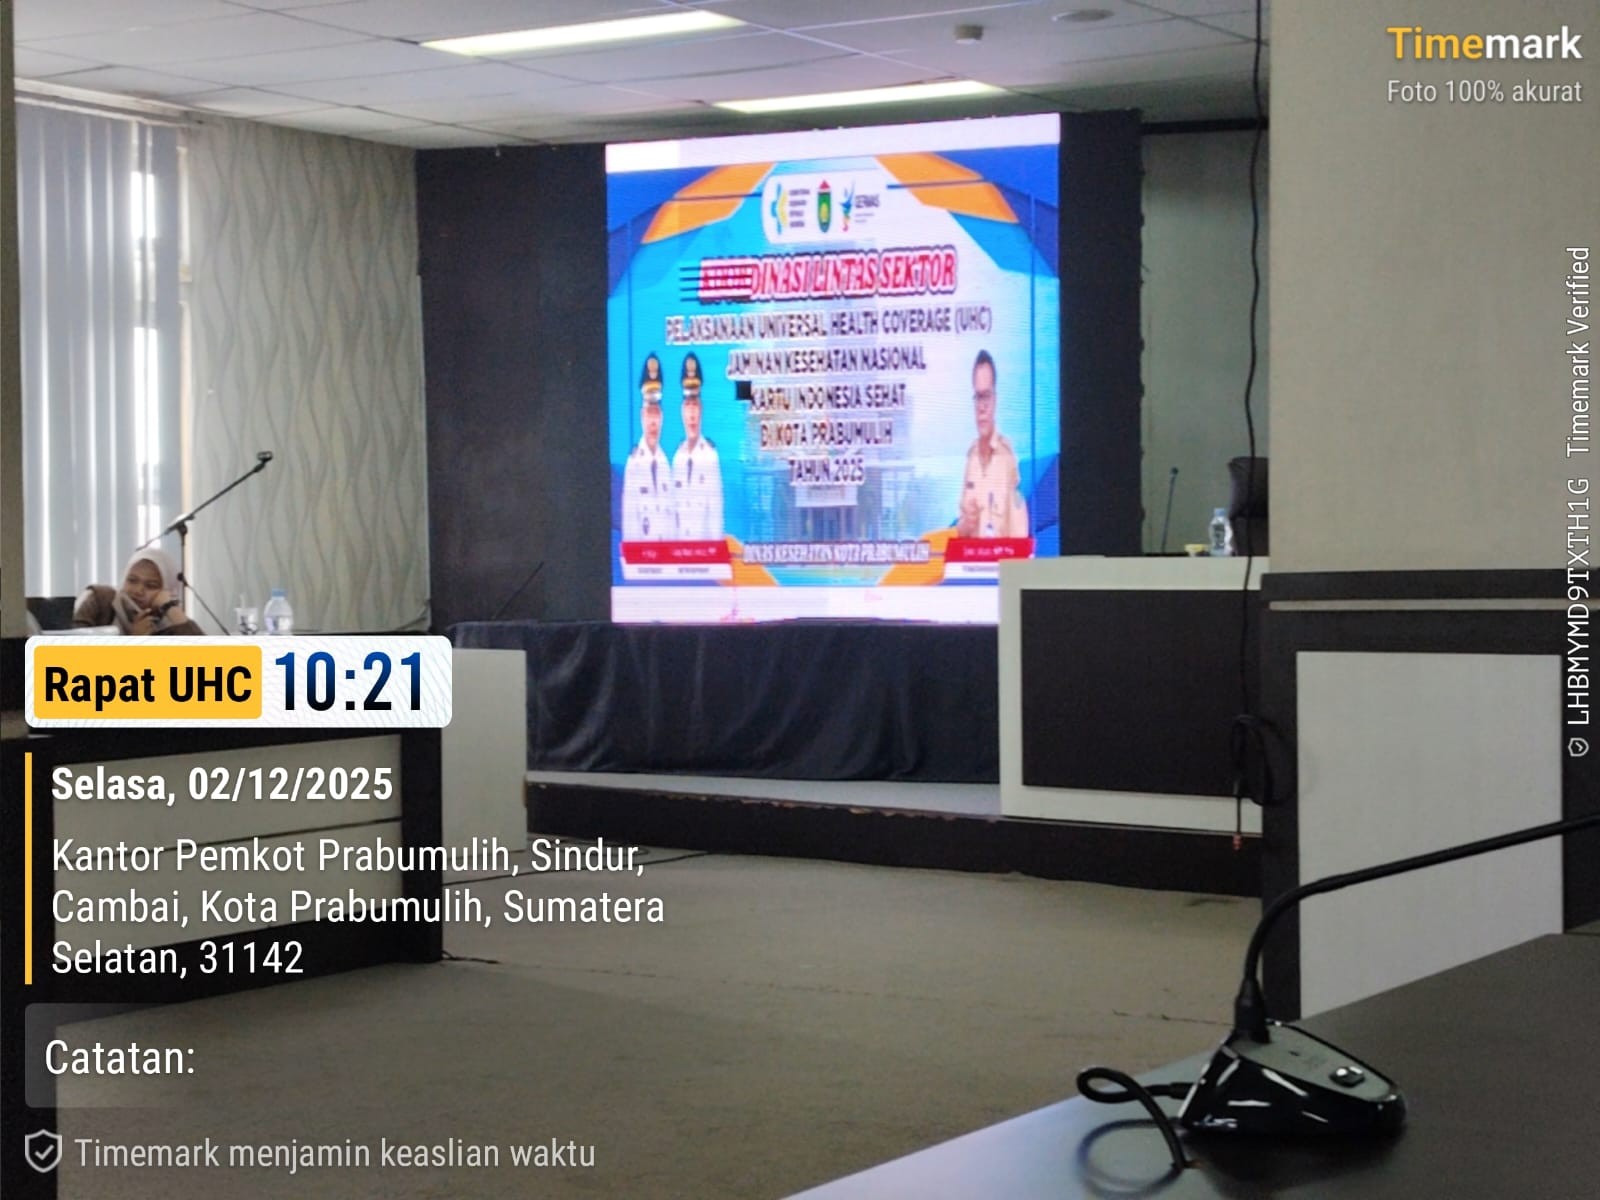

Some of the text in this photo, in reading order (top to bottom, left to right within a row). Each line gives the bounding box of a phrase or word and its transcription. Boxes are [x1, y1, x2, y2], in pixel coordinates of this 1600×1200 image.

[702, 250, 955, 297] DINASI LINTAS SEKTOR
[757, 312, 828, 339] UNIVERSAL
[830, 310, 879, 336] HEALTH
[881, 307, 951, 334] COVERAGE
[953, 305, 992, 334] (UHC)
[785, 349, 859, 374] KESEHATAN
[860, 346, 927, 372] NASIONAL
[750, 383, 906, 411] KARTU INDONESIA SEHAT
[776, 423, 808, 447] KOTA
[810, 421, 893, 446] PRABUMULIH
[789, 458, 864, 483] TAHUN 2025
